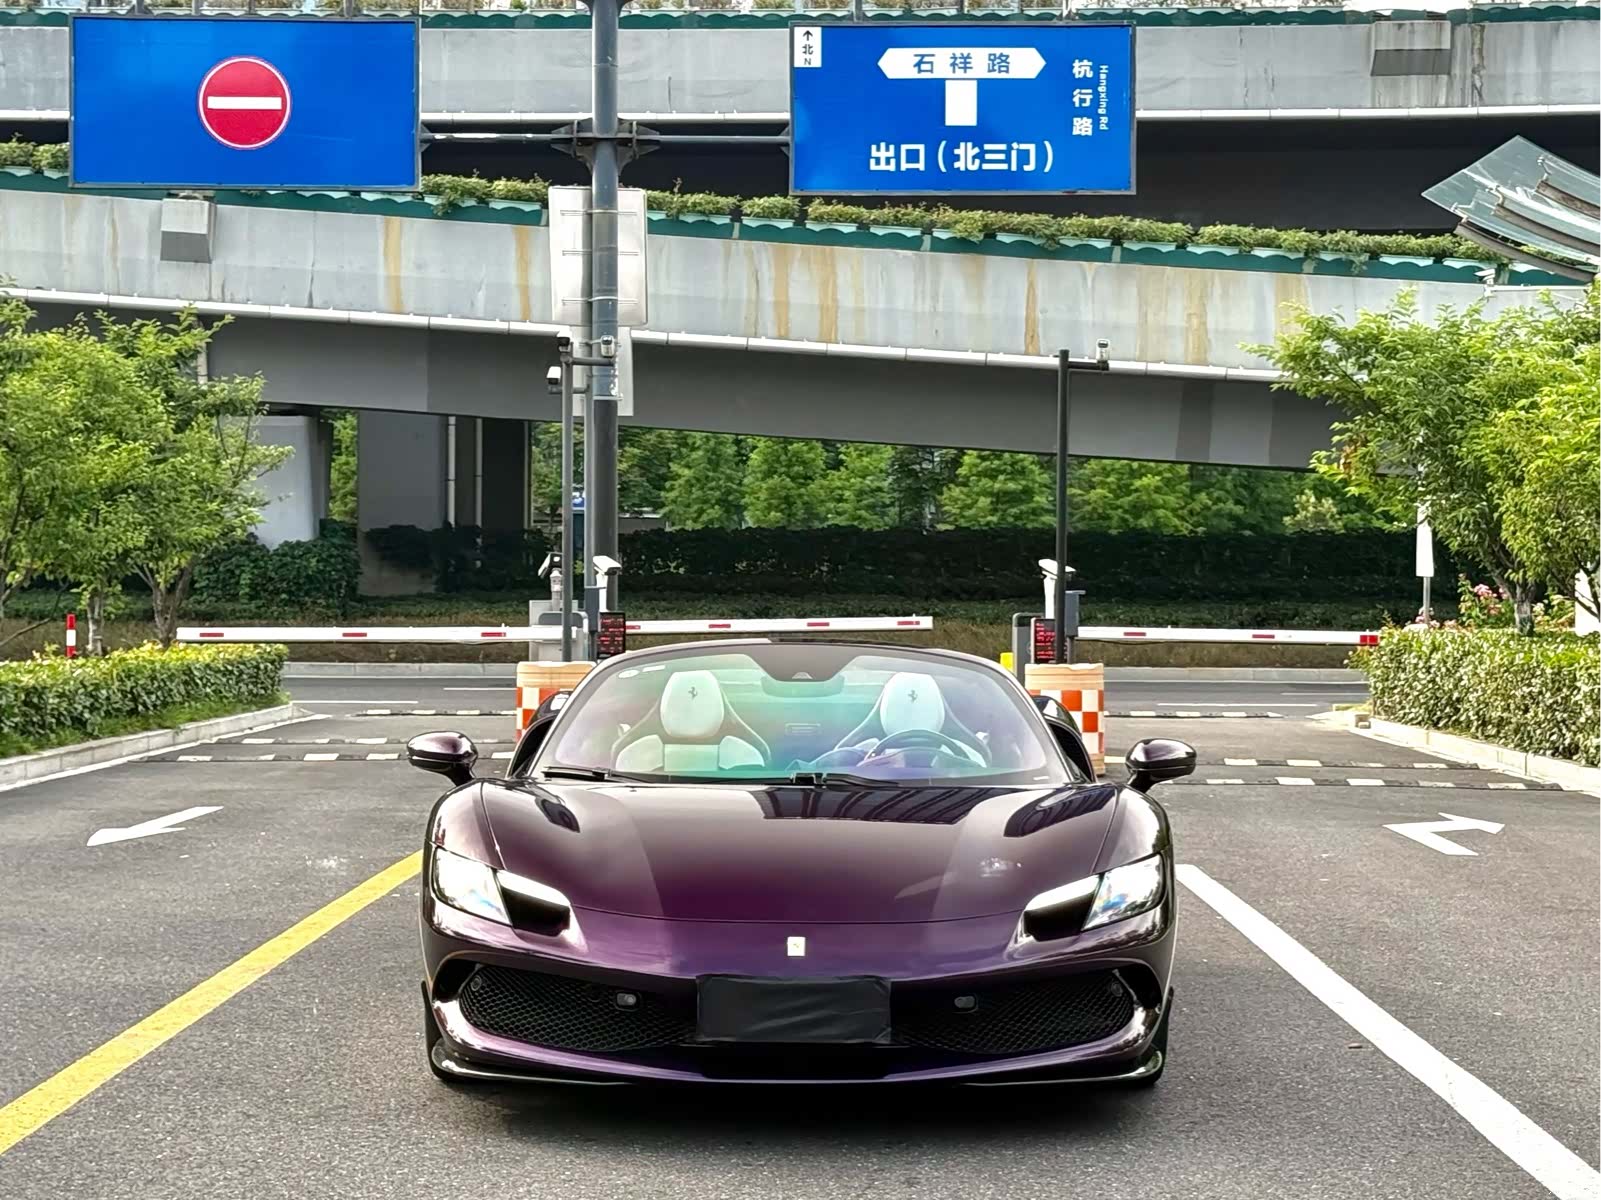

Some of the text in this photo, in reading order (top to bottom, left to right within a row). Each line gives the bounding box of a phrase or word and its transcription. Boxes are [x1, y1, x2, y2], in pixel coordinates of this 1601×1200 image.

[802, 44, 813, 55] 北
[913, 53, 1010, 74] 石祥路
[1072, 59, 1093, 136] 杭行路
[1098, 65, 1109, 130] Hangxing Rd
[869, 141, 1053, 172] 出口（北三门）
